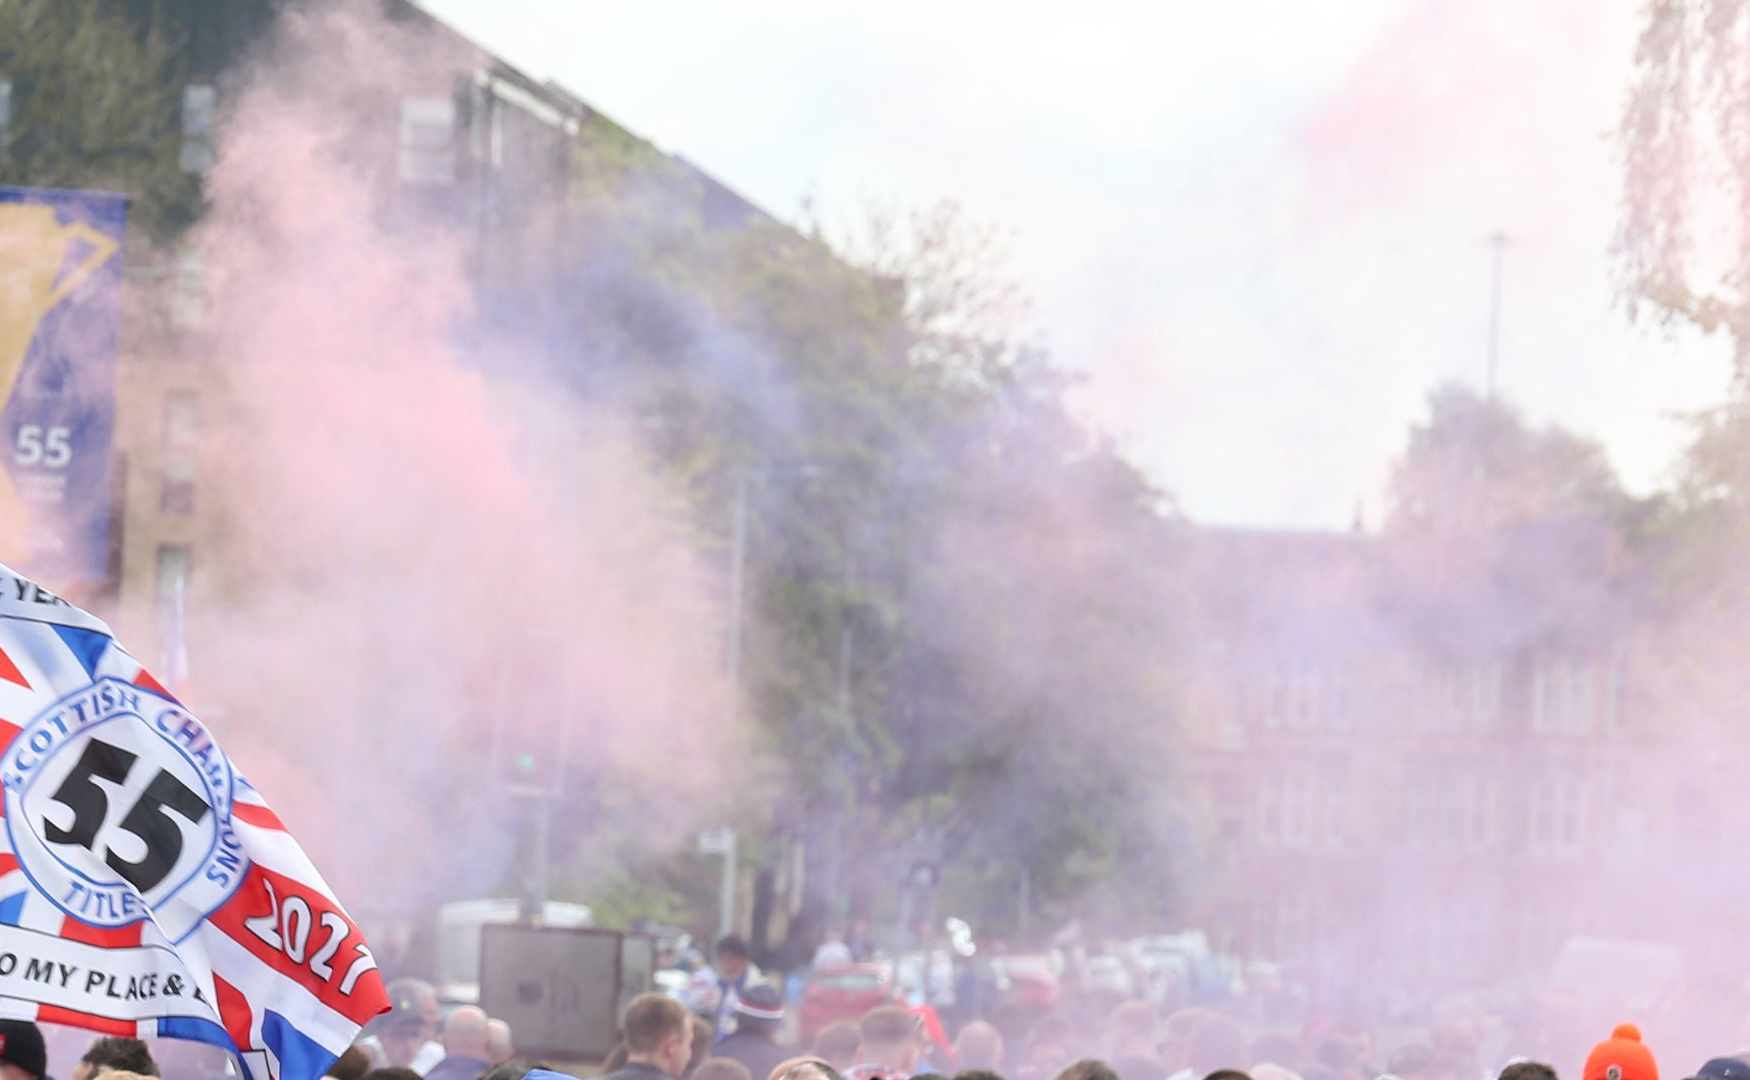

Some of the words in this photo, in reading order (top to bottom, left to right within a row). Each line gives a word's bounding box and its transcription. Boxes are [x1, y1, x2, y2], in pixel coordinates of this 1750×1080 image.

[14, 424, 73, 469] 55
[41, 737, 210, 894] 55
[63, 878, 148, 918] TITLE
[243, 877, 379, 996] 2021
[23, 956, 80, 989] MY
[82, 968, 158, 1003] PLACE
[161, 972, 186, 997] &
